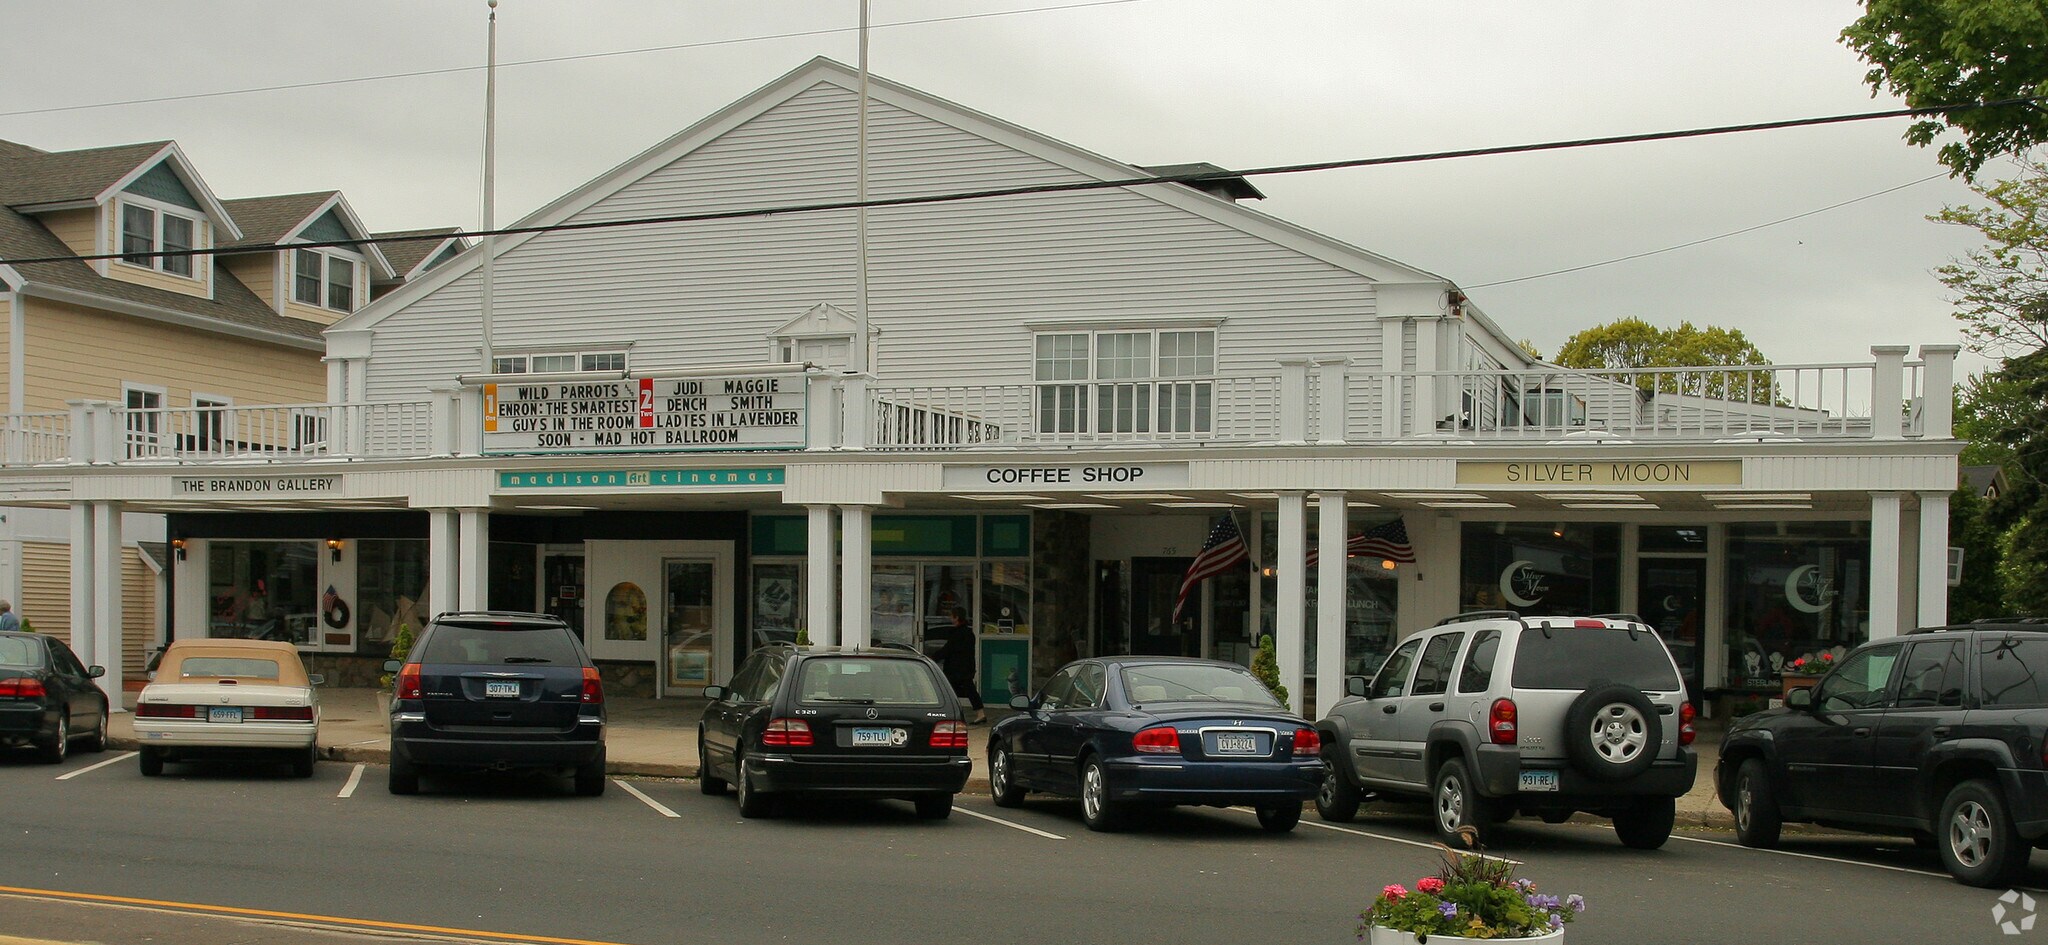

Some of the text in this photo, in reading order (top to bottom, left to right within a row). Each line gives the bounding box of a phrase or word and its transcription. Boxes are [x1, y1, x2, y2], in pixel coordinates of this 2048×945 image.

[518, 387, 549, 400] WILD
[560, 384, 619, 399] PARROTS
[673, 379, 779, 396] JUDI MAGGIE
[486, 394, 494, 414] 1
[640, 389, 653, 410] 2
[667, 395, 773, 412] DENCH SMITH
[499, 400, 637, 416] ENRON: THE SMARTEST
[512, 416, 635, 432] GUYS IN THE ROOM
[656, 411, 799, 428] LADIES IN LAVENDER
[538, 433, 571, 447] SOON
[595, 432, 622, 446] MAD
[630, 431, 656, 445] HOT
[666, 429, 739, 444] BALLROOM
[511, 471, 773, 485] madison Art cinemas
[986, 467, 1144, 483] COFFEE SHOP
[1507, 463, 1690, 482] SILVER MOON
[182, 479, 333, 492] THE BRANDON GALLERY
[1347, 600, 1378, 609] LUNCH
